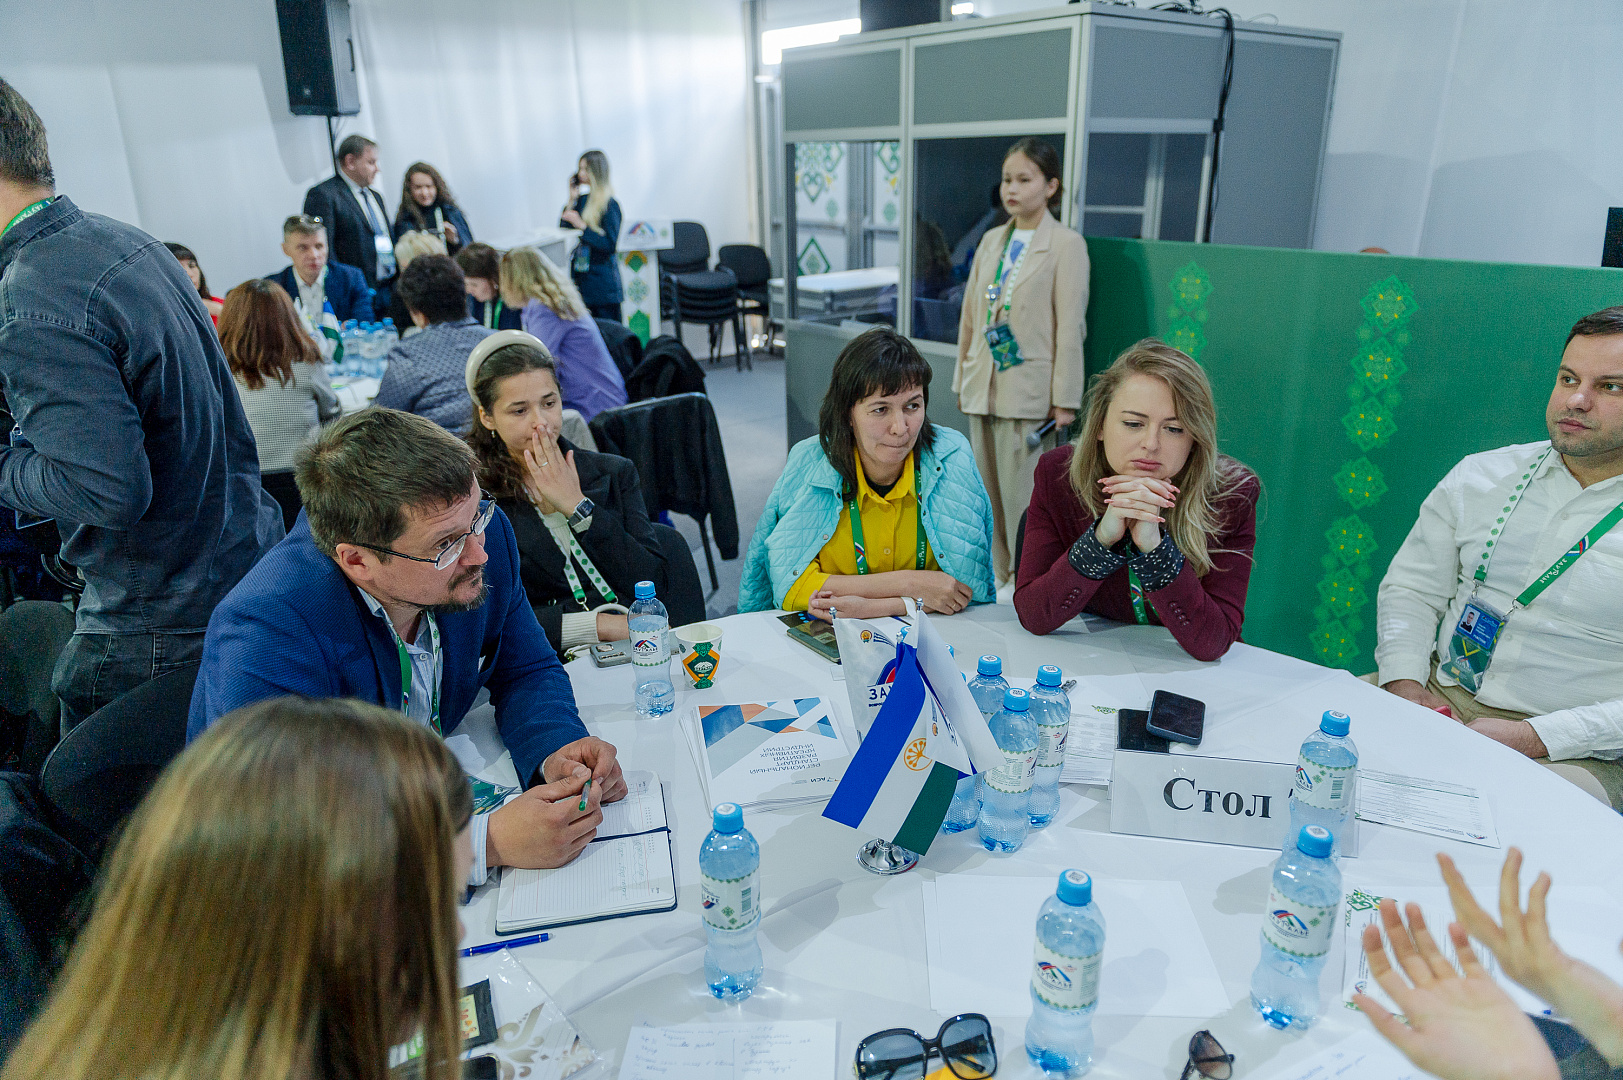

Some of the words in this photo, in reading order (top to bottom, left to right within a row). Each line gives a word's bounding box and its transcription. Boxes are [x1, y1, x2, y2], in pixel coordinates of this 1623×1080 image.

[759, 747, 816, 758] КРЕАТИВНЫХ
[762, 743, 814, 753] ИНДУСТРИИ
[772, 752, 818, 762] РАЗВИТИЯ
[775, 757, 819, 767] СТАНДАРТ
[749, 763, 821, 775] РЕГИОНАЛЬНЫЙ
[1163, 777, 1272, 818] Стол
